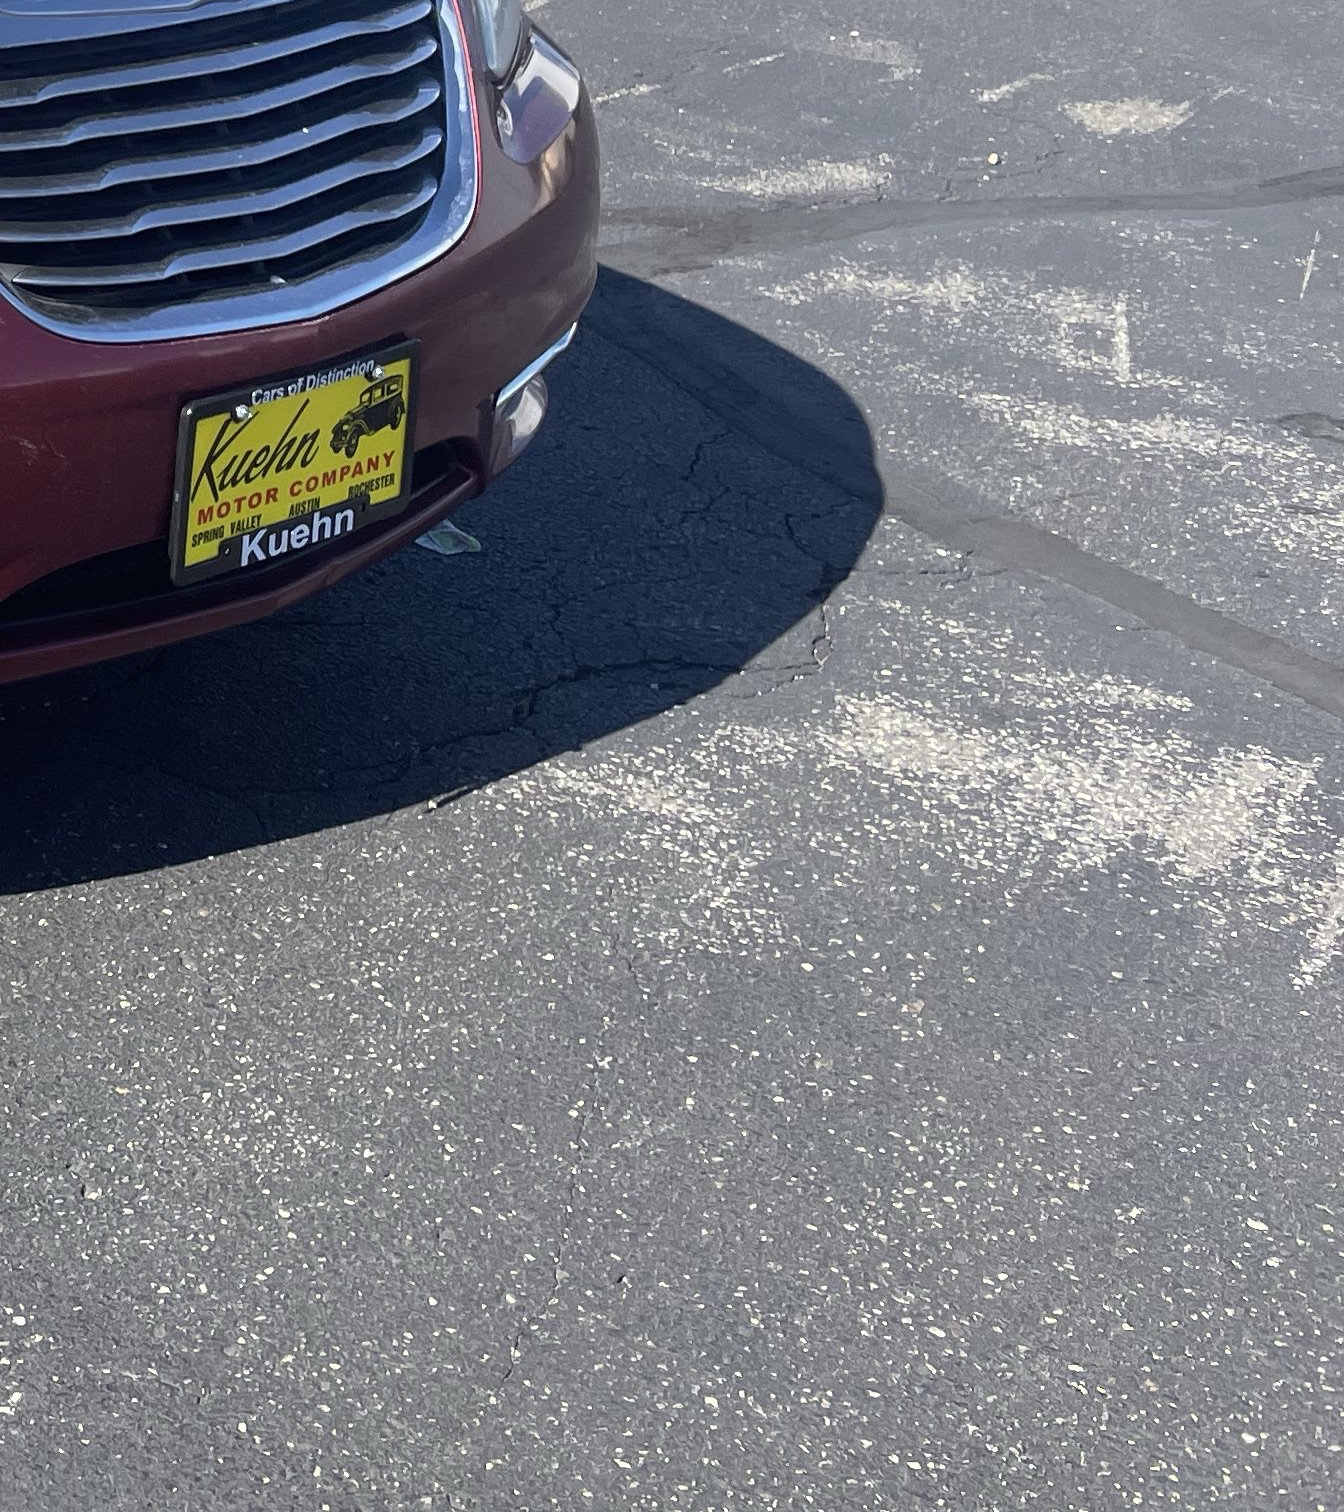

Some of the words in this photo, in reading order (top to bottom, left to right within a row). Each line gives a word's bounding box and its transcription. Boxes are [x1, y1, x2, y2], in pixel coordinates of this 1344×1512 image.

[251, 384, 284, 404] Cars
[288, 377, 305, 395] of
[306, 359, 375, 390] Distinction
[191, 398, 321, 503] Kuehn
[197, 487, 279, 526] MOTOR
[289, 450, 395, 497] COMPANY
[191, 524, 225, 548] SPRING
[230, 513, 262, 535] VALLEY
[288, 497, 321, 517] AUSTIN
[348, 473, 395, 499] ROCHESTER
[240, 506, 354, 567] Kuehn
